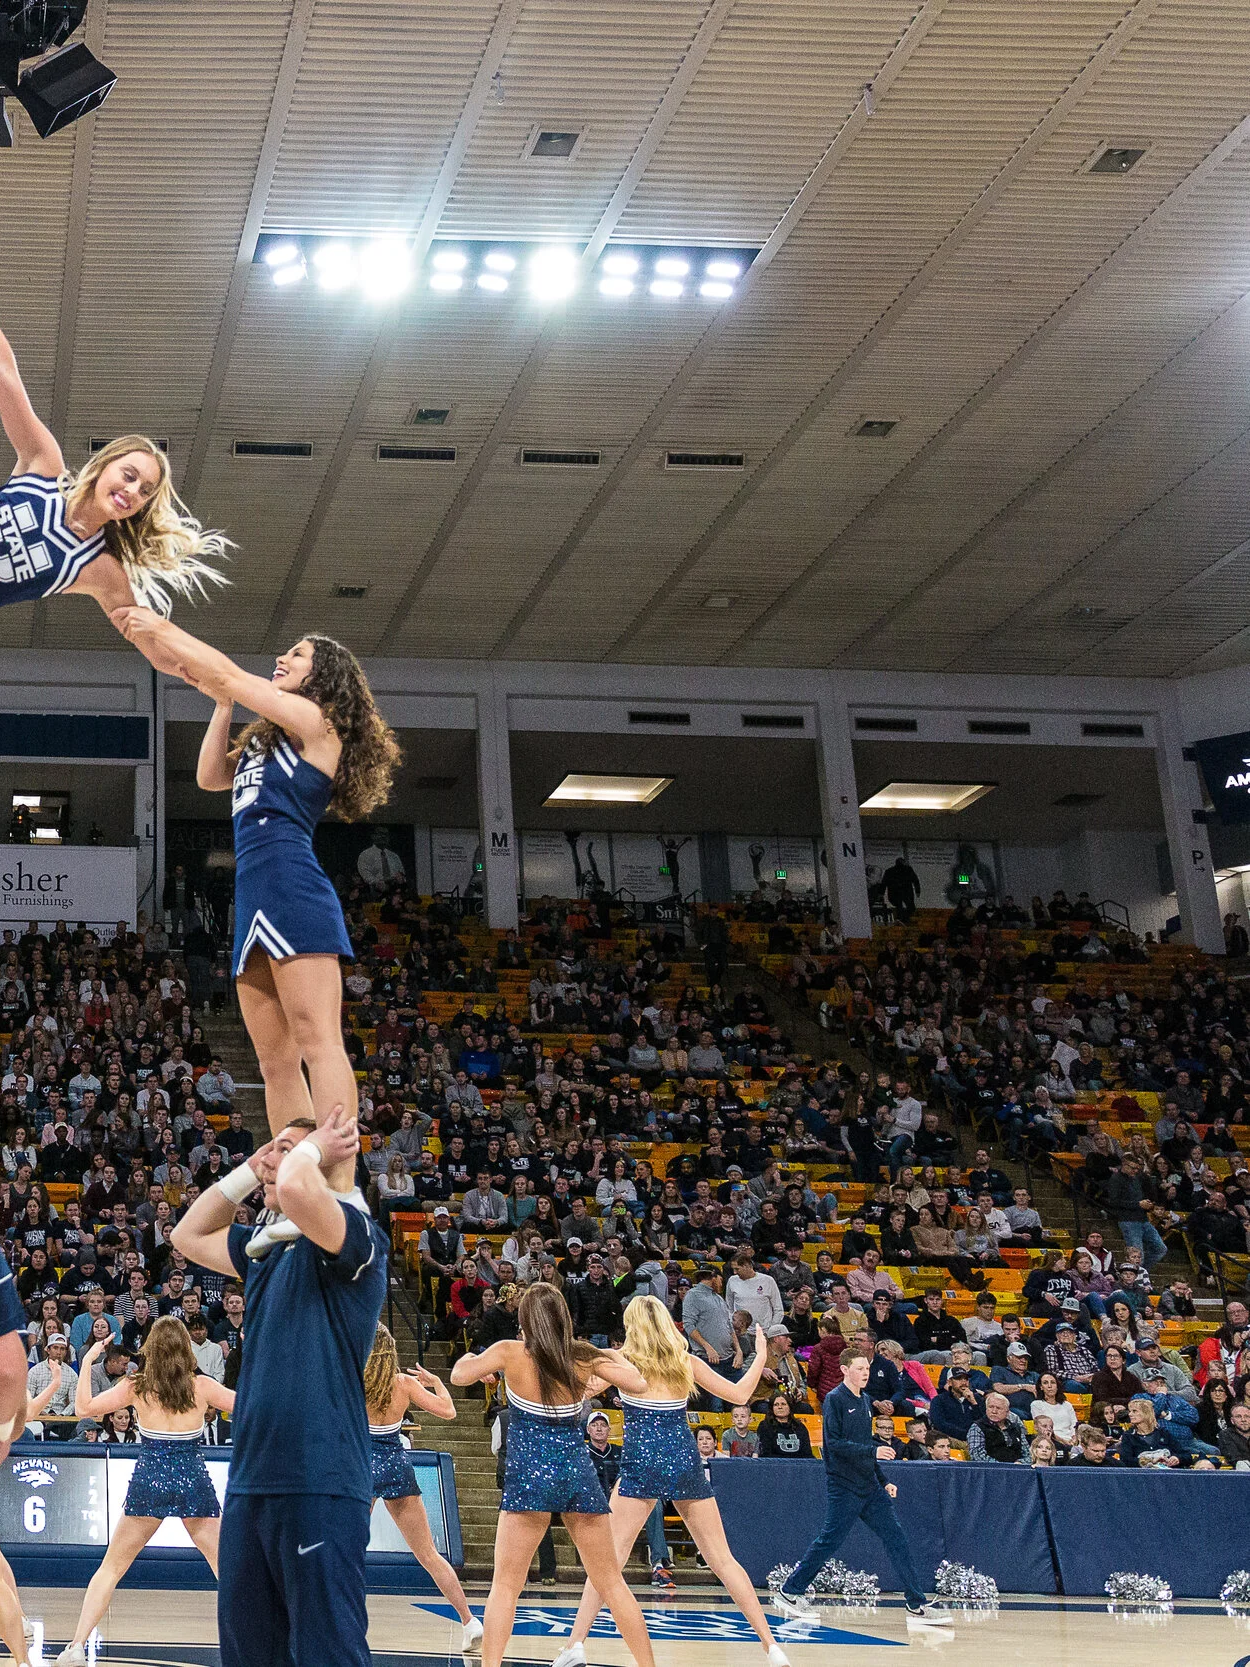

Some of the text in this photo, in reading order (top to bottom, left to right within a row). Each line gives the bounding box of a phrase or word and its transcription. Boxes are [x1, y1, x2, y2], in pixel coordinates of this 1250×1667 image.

[491, 832, 508, 847] M
[842, 842, 857, 858] N
[1191, 850, 1204, 865] P
[2, 894, 74, 910] Furnishings
[1046, 1278, 1072, 1291] UTAH
[12, 1459, 59, 1475] NEVADA
[23, 1495, 46, 1533] 6
